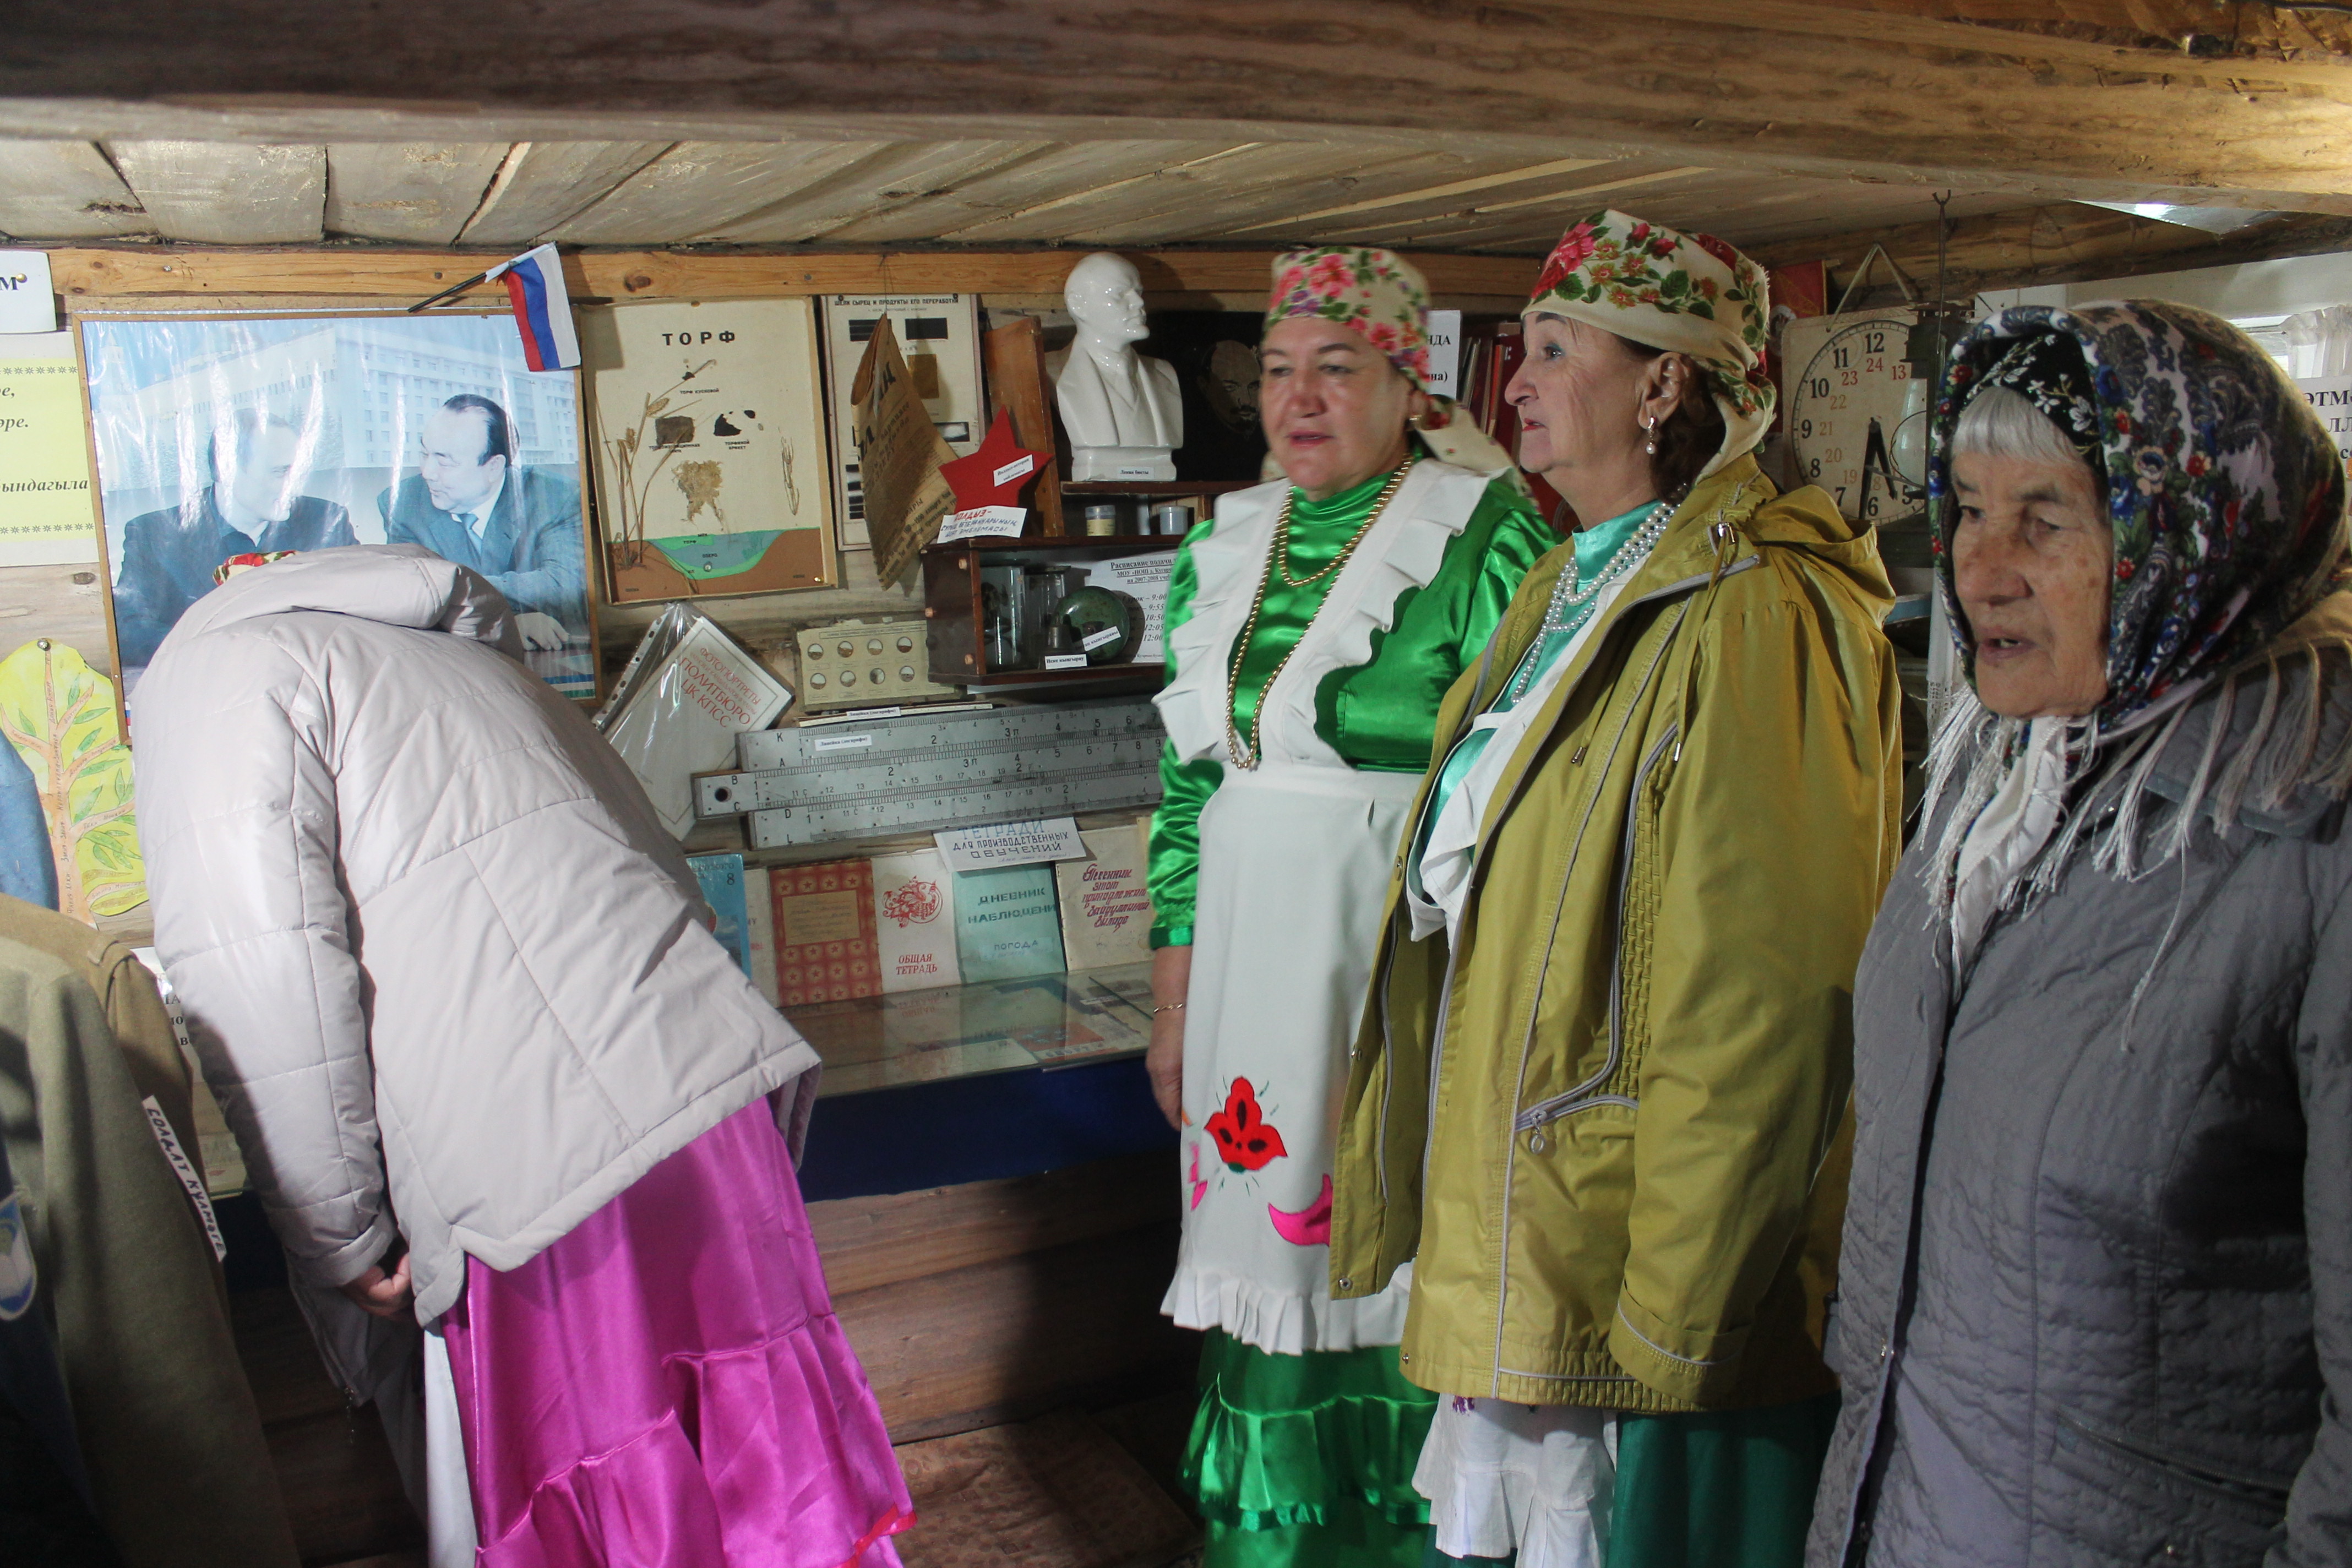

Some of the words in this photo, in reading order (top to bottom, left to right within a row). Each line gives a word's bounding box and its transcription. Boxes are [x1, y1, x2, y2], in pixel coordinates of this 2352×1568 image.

[662, 330, 736, 346] ТОРФ
[1865, 332, 1884, 353] 12
[1833, 347, 1848, 369] 11
[1866, 357, 1883, 372] 24
[1842, 371, 1858, 385] 23
[1892, 365, 1906, 380] 13
[1811, 378, 1830, 398] 10
[1830, 395, 1847, 410] 22
[1801, 419, 1812, 438] 9
[1820, 421, 1833, 436] 21
[1825, 448, 1842, 463] 20
[1810, 458, 1821, 477] 8
[1844, 470, 1857, 484] 19
[1835, 487, 1846, 507] 7
[1868, 497, 1879, 516] 6
[1111, 559, 1148, 569] Расписание
[700, 647, 761, 705] ФОТОПОРТРЕТЫ
[679, 658, 750, 725] ПОЛИТБЮРО
[681, 679, 700, 699] ЦК
[697, 694, 731, 727] КПСС
[777, 733, 783, 742] K
[785, 809, 791, 818] D
[958, 819, 1044, 840] ТЕТРАДИ
[787, 834, 793, 843] L
[953, 841, 973, 851] ДЛЯ
[977, 831, 1069, 848] ПРОИЗВОДСТВЕННЫХ
[971, 842, 1061, 859] ОБУЧЕНИЙ
[727, 873, 734, 885] 8
[1082, 863, 1133, 881] Песенник
[1092, 881, 1119, 891] этот
[978, 887, 1046, 906] ДНЕВНИК
[994, 940, 1038, 951] ПОГОДА
[899, 954, 932, 964] ОБЩАЯ
[896, 963, 938, 975] ТЕТРАДЬ
[147, 1107, 190, 1172] СОЛДАТ
